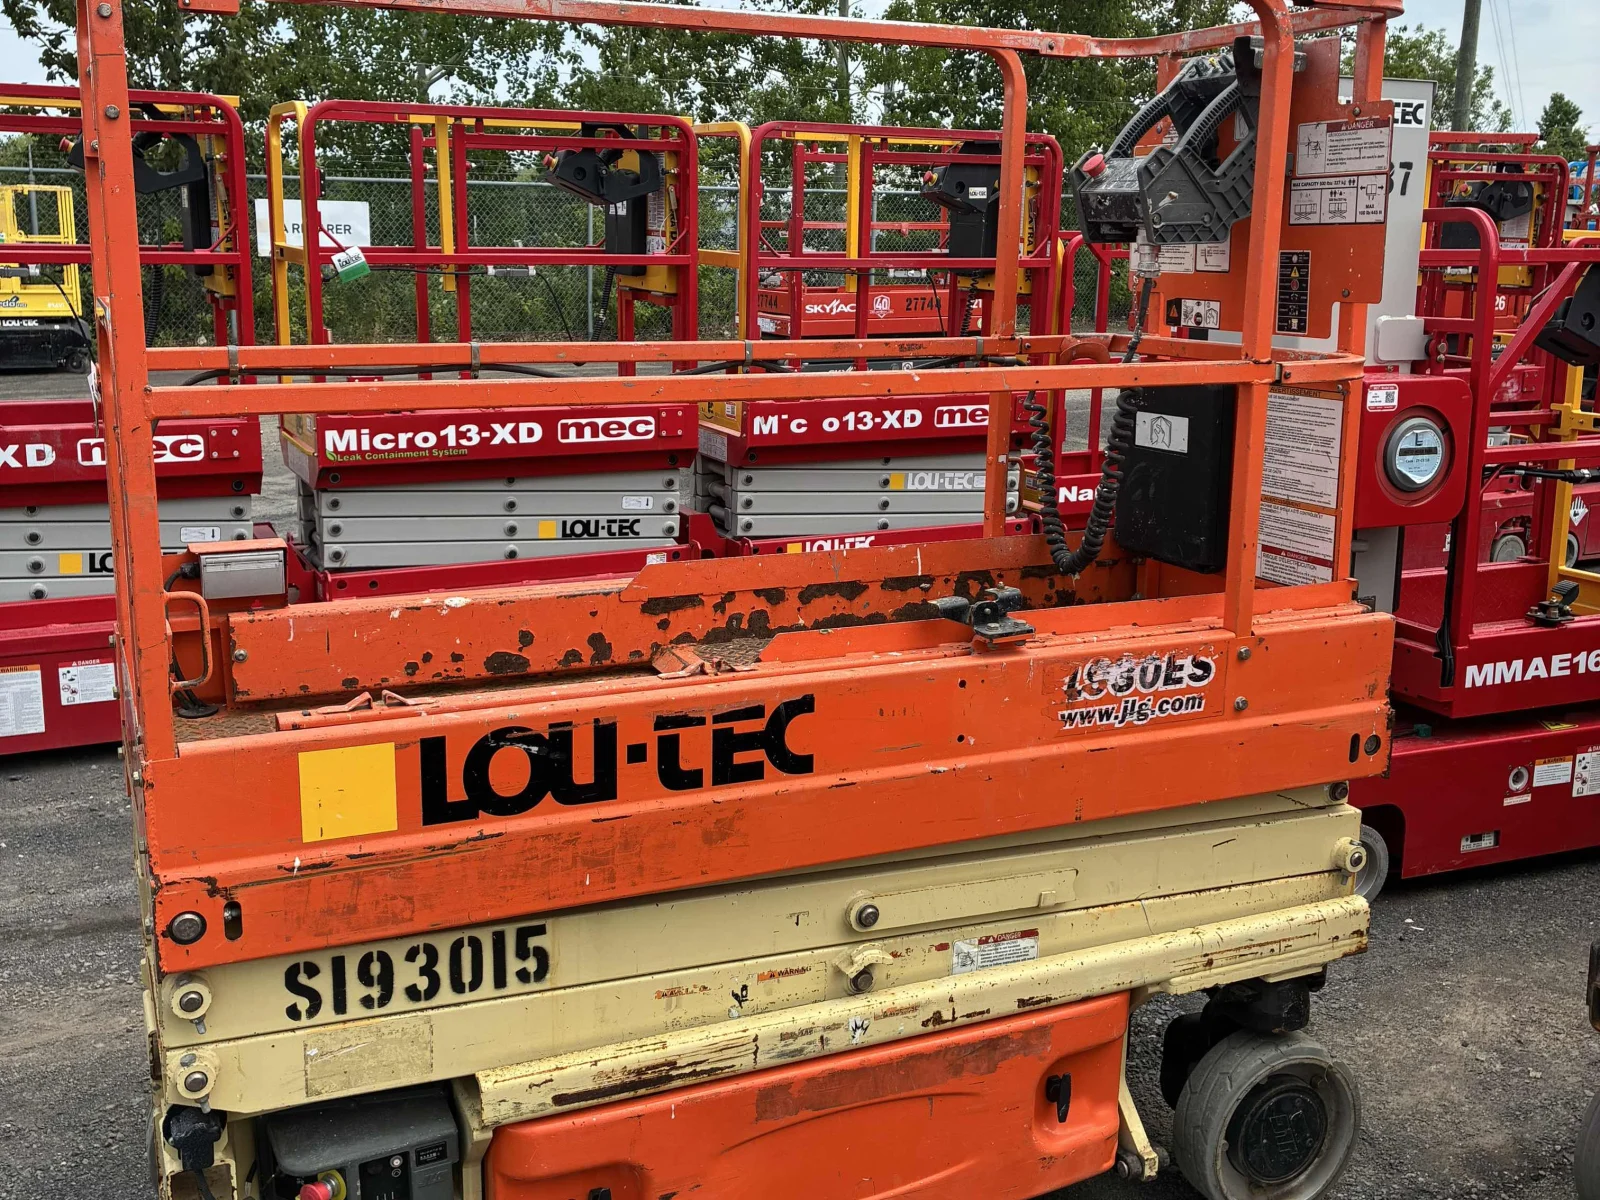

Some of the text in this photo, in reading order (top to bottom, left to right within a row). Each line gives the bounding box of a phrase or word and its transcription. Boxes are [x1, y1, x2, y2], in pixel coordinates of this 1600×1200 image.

[805, 299, 857, 315] SKYJAC
[936, 407, 989, 425] me
[325, 418, 655, 452] Micro13-XD mec
[338, 448, 468, 462] Leak Containment System
[908, 473, 973, 489] LOU-TEC
[561, 518, 640, 538] LOU-TEC
[1060, 694, 1203, 727] www.jlg.com
[419, 694, 815, 827] LOU-TEC
[997, 931, 1022, 941] DANGER
[285, 924, 550, 1022] S193015
